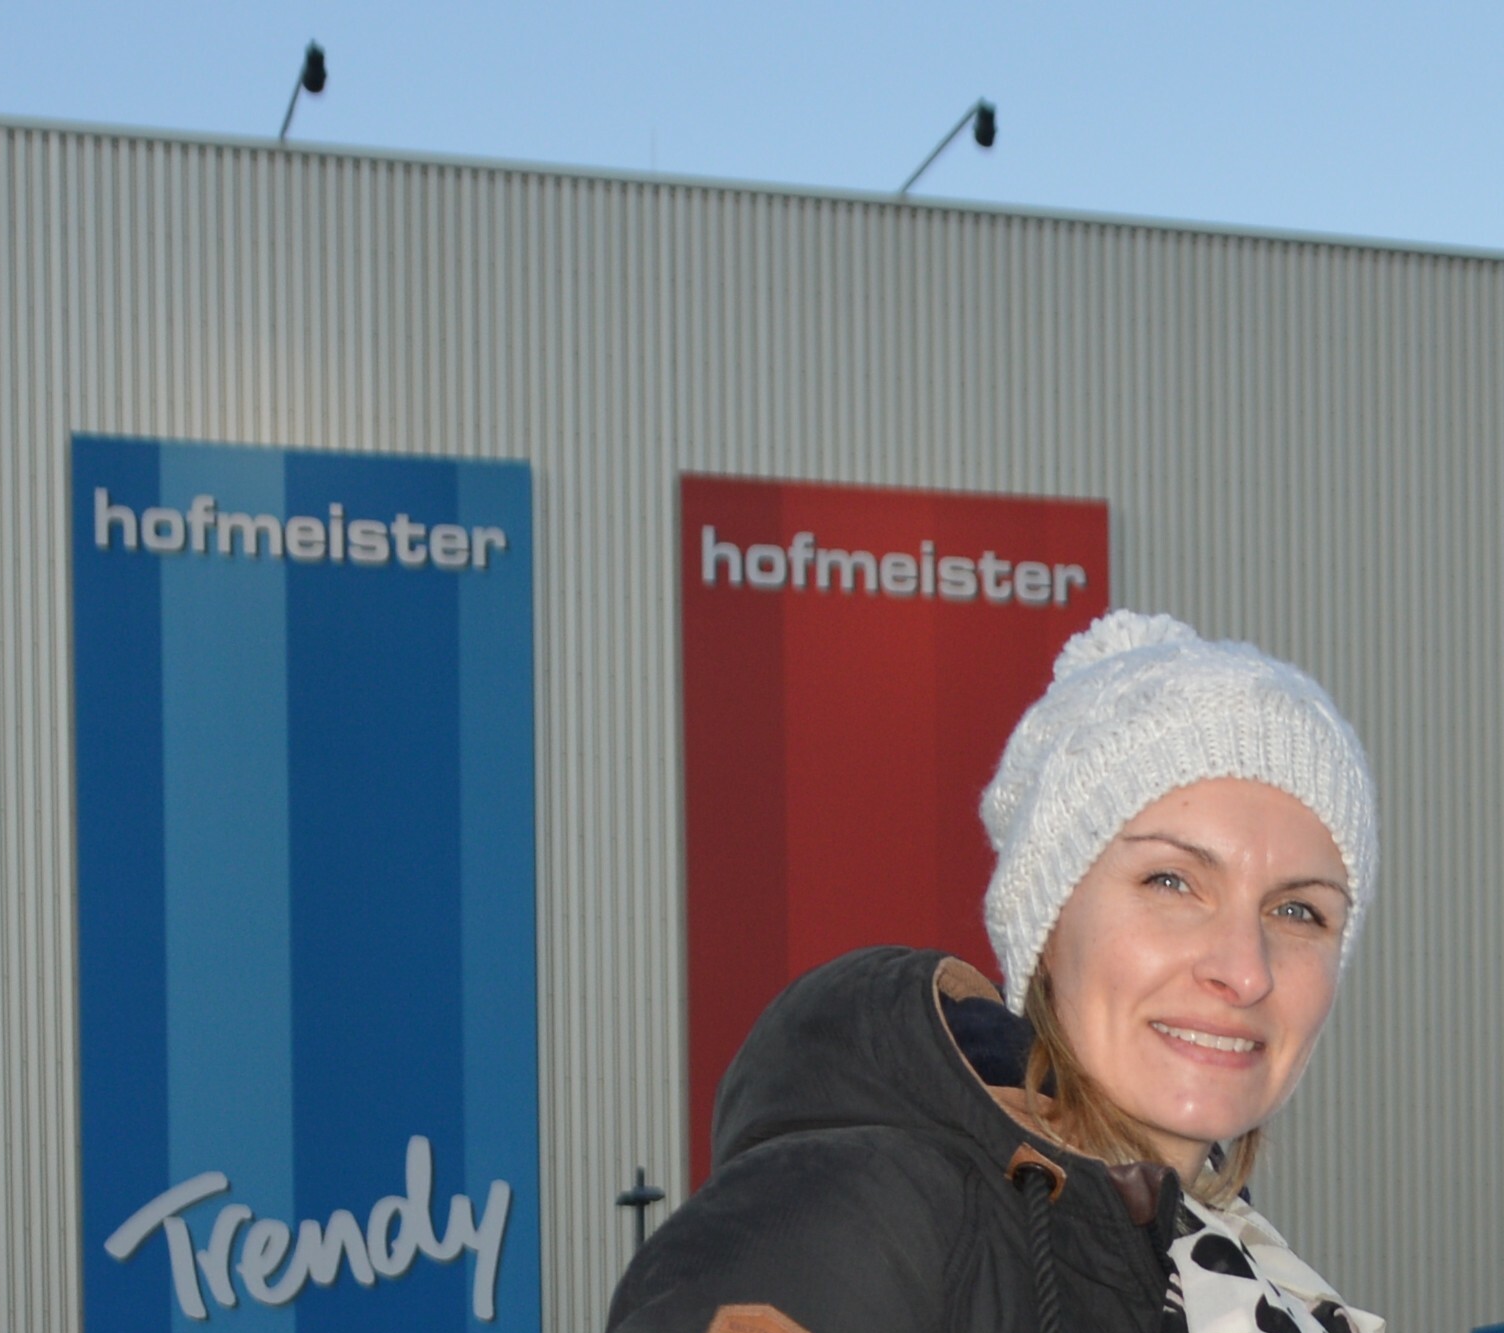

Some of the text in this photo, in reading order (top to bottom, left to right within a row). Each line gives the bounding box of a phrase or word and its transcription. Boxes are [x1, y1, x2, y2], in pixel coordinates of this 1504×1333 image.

[94, 488, 508, 569] hofmeister
[701, 525, 1087, 606] hofmeister
[104, 1133, 511, 1319] Trendy
